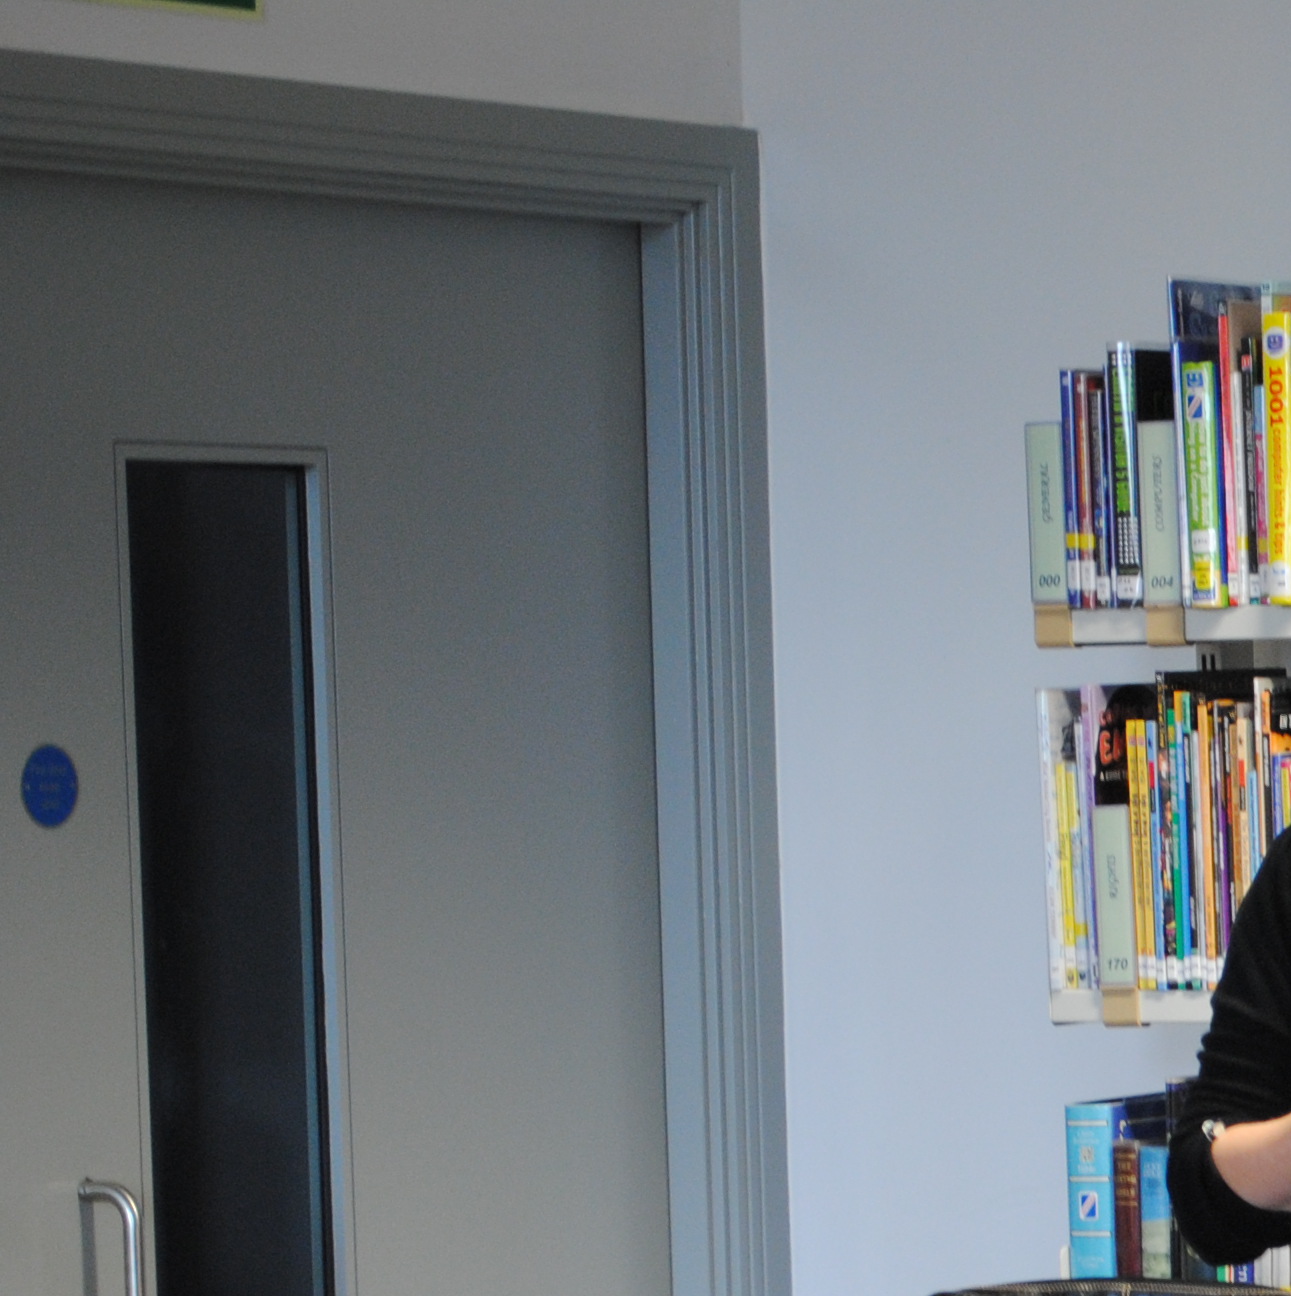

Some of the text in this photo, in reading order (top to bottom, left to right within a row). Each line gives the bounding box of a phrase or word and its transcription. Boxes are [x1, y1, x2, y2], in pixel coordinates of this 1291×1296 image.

[1268, 367, 1284, 427] 1001
[1039, 575, 1061, 587] 000
[1151, 577, 1174, 588] 004
[1107, 957, 1128, 972] 170
